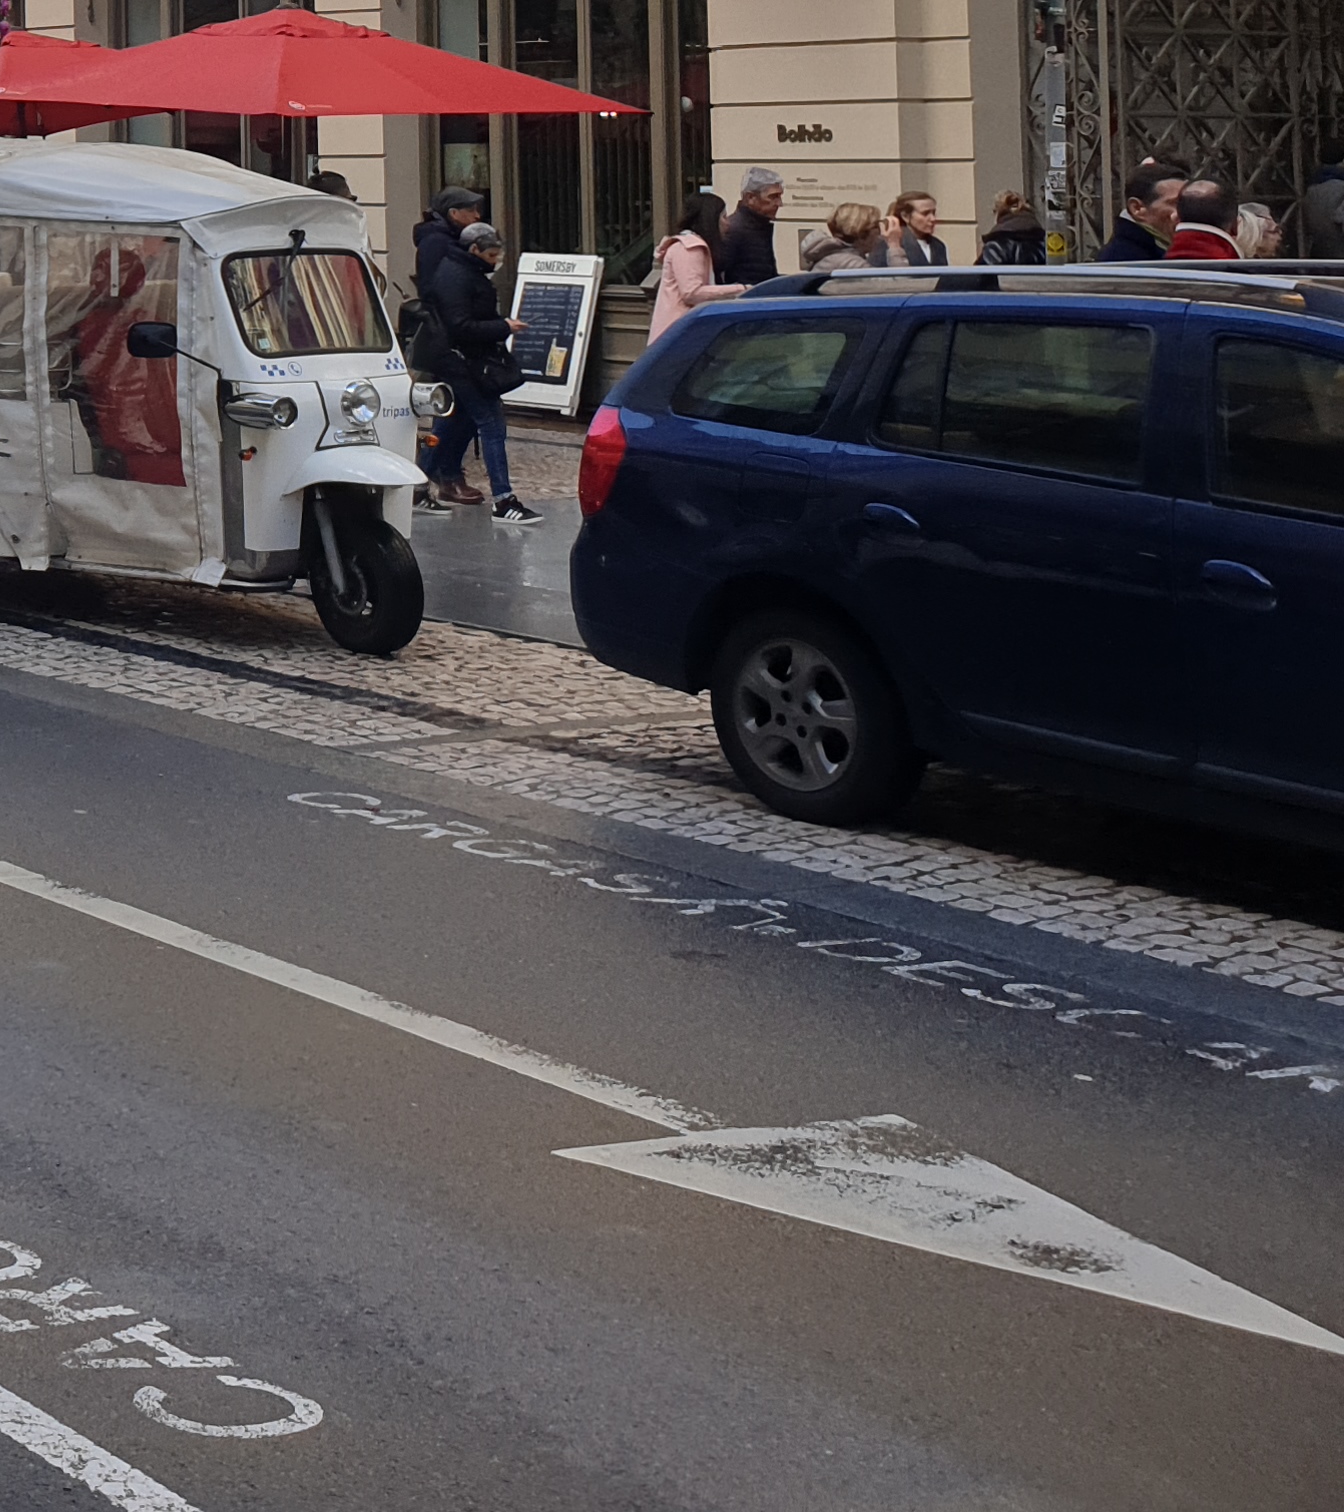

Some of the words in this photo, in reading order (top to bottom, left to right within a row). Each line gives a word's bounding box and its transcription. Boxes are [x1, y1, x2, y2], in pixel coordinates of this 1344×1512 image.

[777, 123, 833, 143] Bolhão
[534, 260, 577, 273] SOMERSBY
[382, 405, 410, 419] tripas
